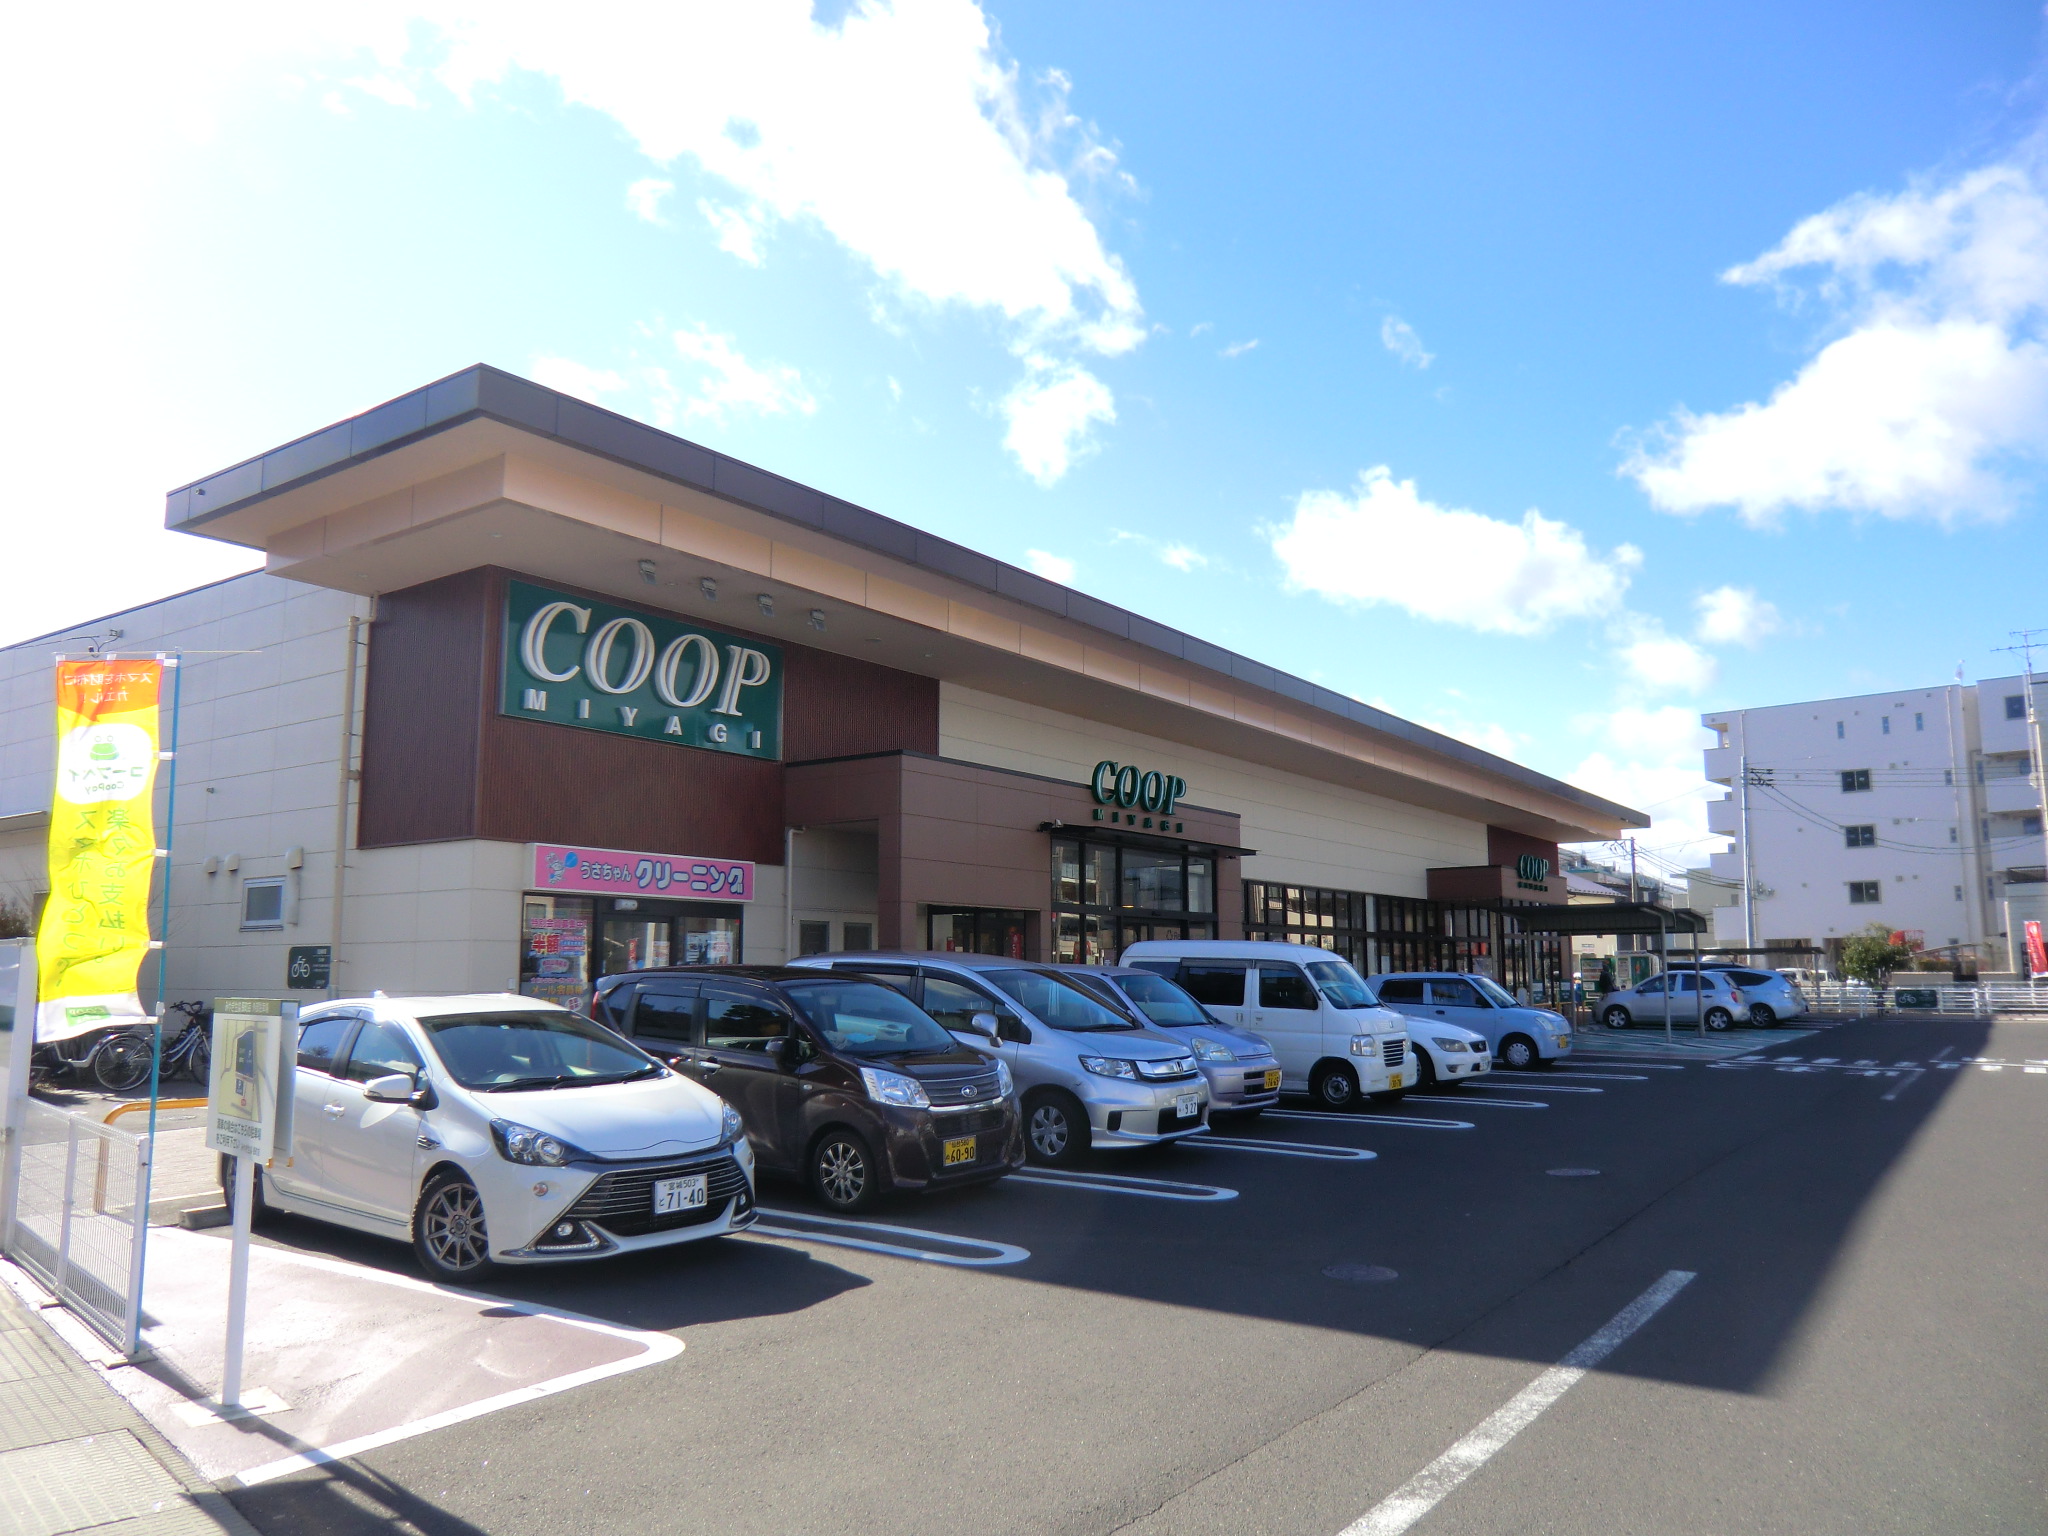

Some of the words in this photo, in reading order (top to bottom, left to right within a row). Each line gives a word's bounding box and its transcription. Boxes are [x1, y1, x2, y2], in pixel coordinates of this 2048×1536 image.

[521, 601, 771, 717] COOP
[523, 688, 762, 750] MIYAGI
[1091, 760, 1187, 816] COOP
[1519, 854, 1550, 882] COOP
[667, 1188, 704, 1209] 71-40
